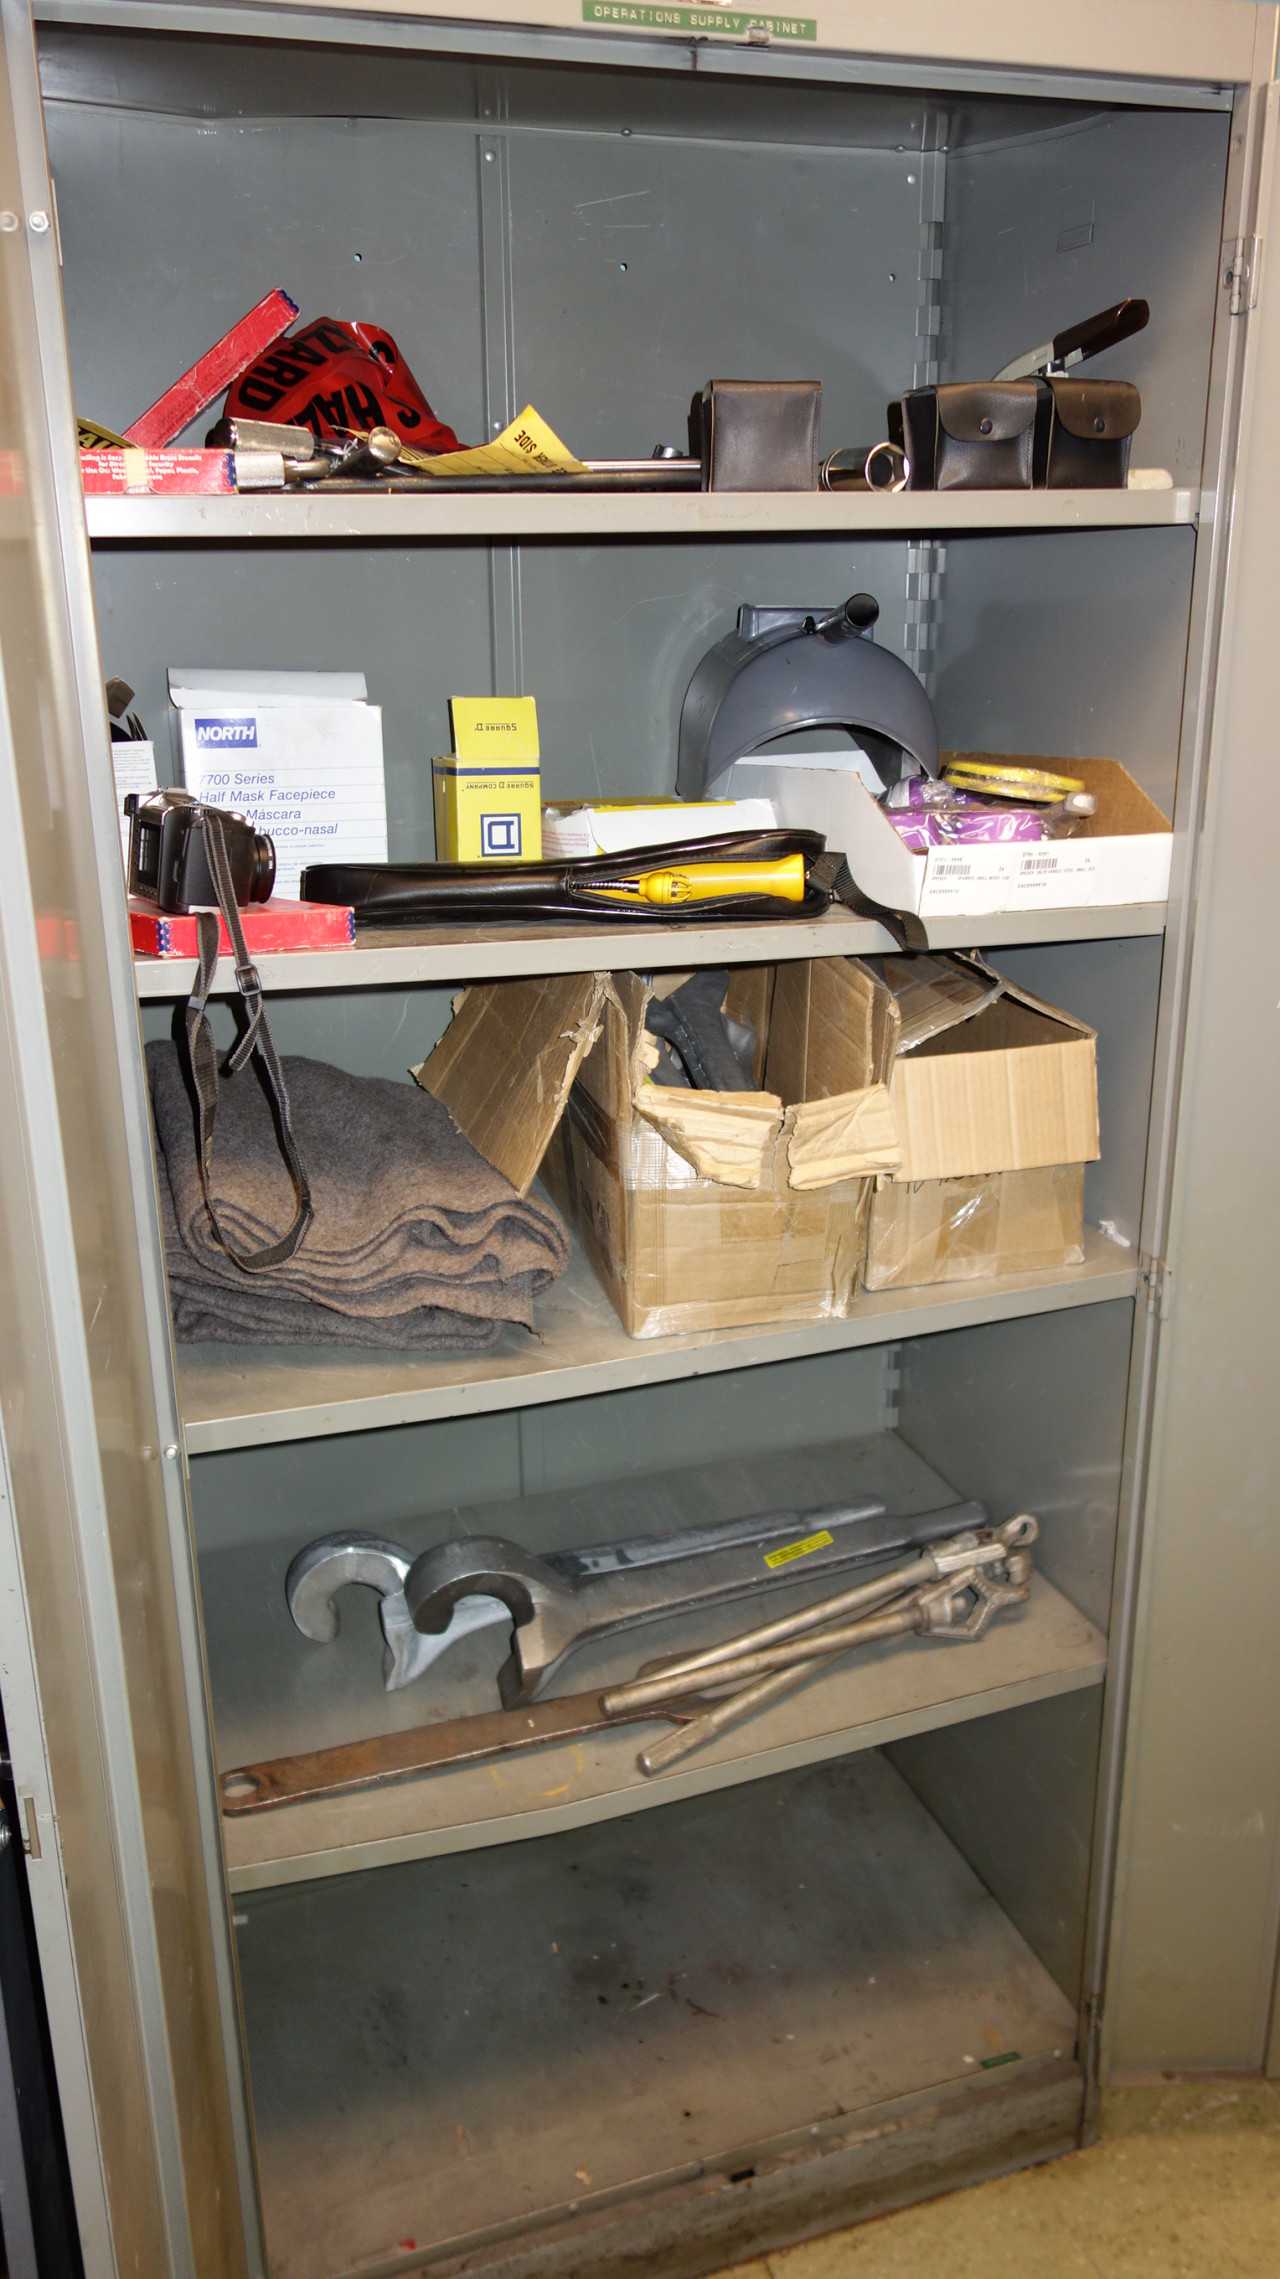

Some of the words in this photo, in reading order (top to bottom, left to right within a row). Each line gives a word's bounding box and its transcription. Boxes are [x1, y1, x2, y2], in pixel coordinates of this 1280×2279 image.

[594, 6, 681, 24] OPERATIONS
[690, 14, 741, 29] SUPPLY
[513, 429, 537, 454] SIDE
[197, 726, 255, 741] NORTH
[234, 773, 275, 785] Series
[200, 791, 227, 803] Half
[230, 790, 265, 802] Mask
[269, 789, 336, 802] Facepiece
[258, 823, 338, 836] bucco-nasal
